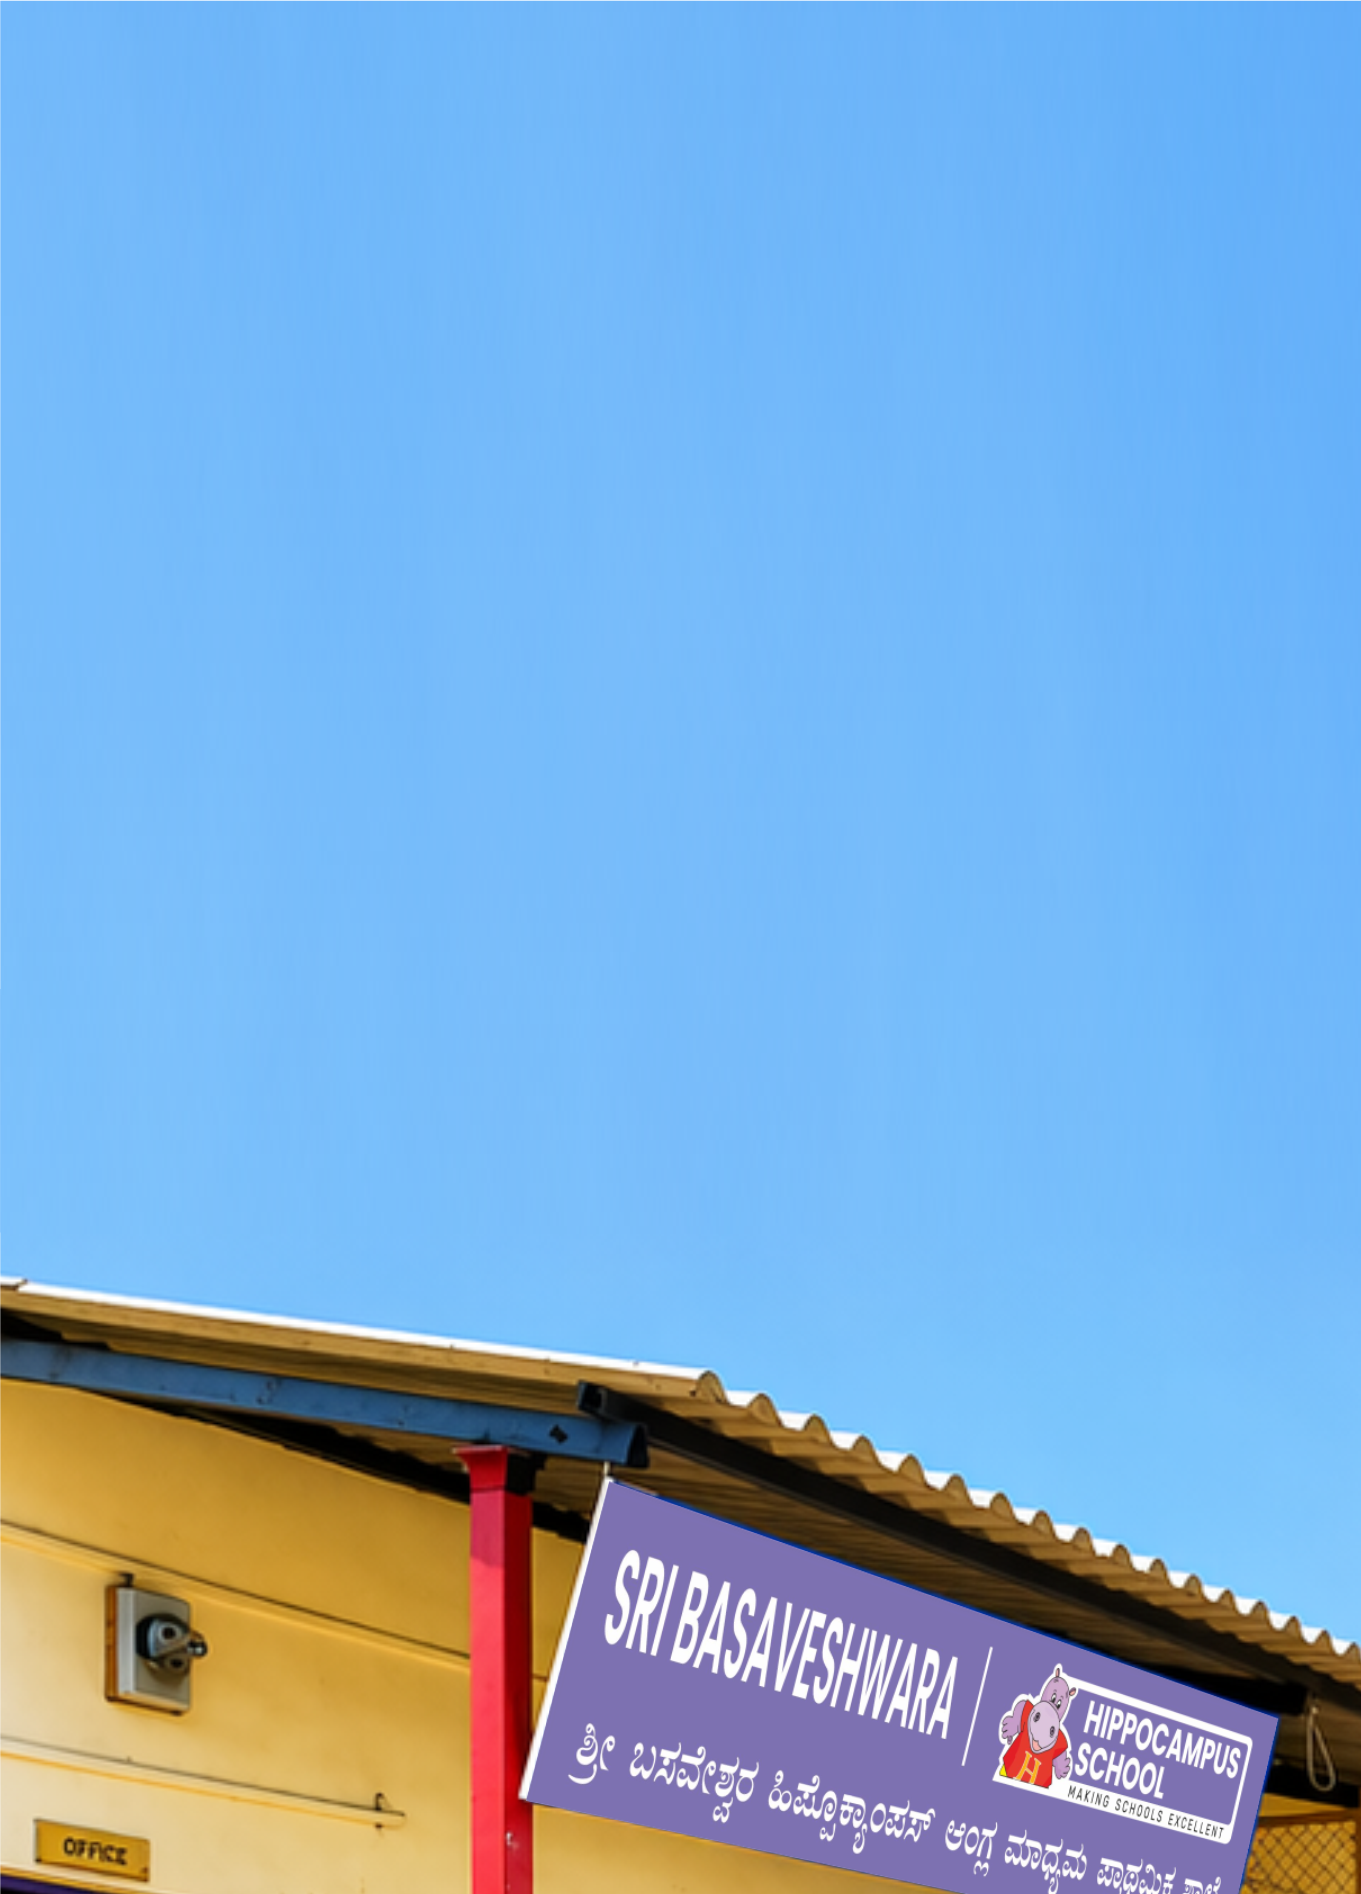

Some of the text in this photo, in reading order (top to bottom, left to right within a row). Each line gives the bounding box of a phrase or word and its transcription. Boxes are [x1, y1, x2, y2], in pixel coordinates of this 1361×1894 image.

[604, 1549, 959, 1740] SRI BASAVESHWARA
[567, 1722, 616, 1785] ಶ್ರೀ
[629, 1742, 760, 1824] ಬಸವೇಶ್ವರ
[1074, 1742, 1166, 1800] SCHOOL
[1083, 1700, 1241, 1779] HIPPOCAMPUS
[1067, 1784, 1225, 1840] MAKING SCHOOLS EXCELLENT
[63, 1836, 128, 1867] OFFICE
